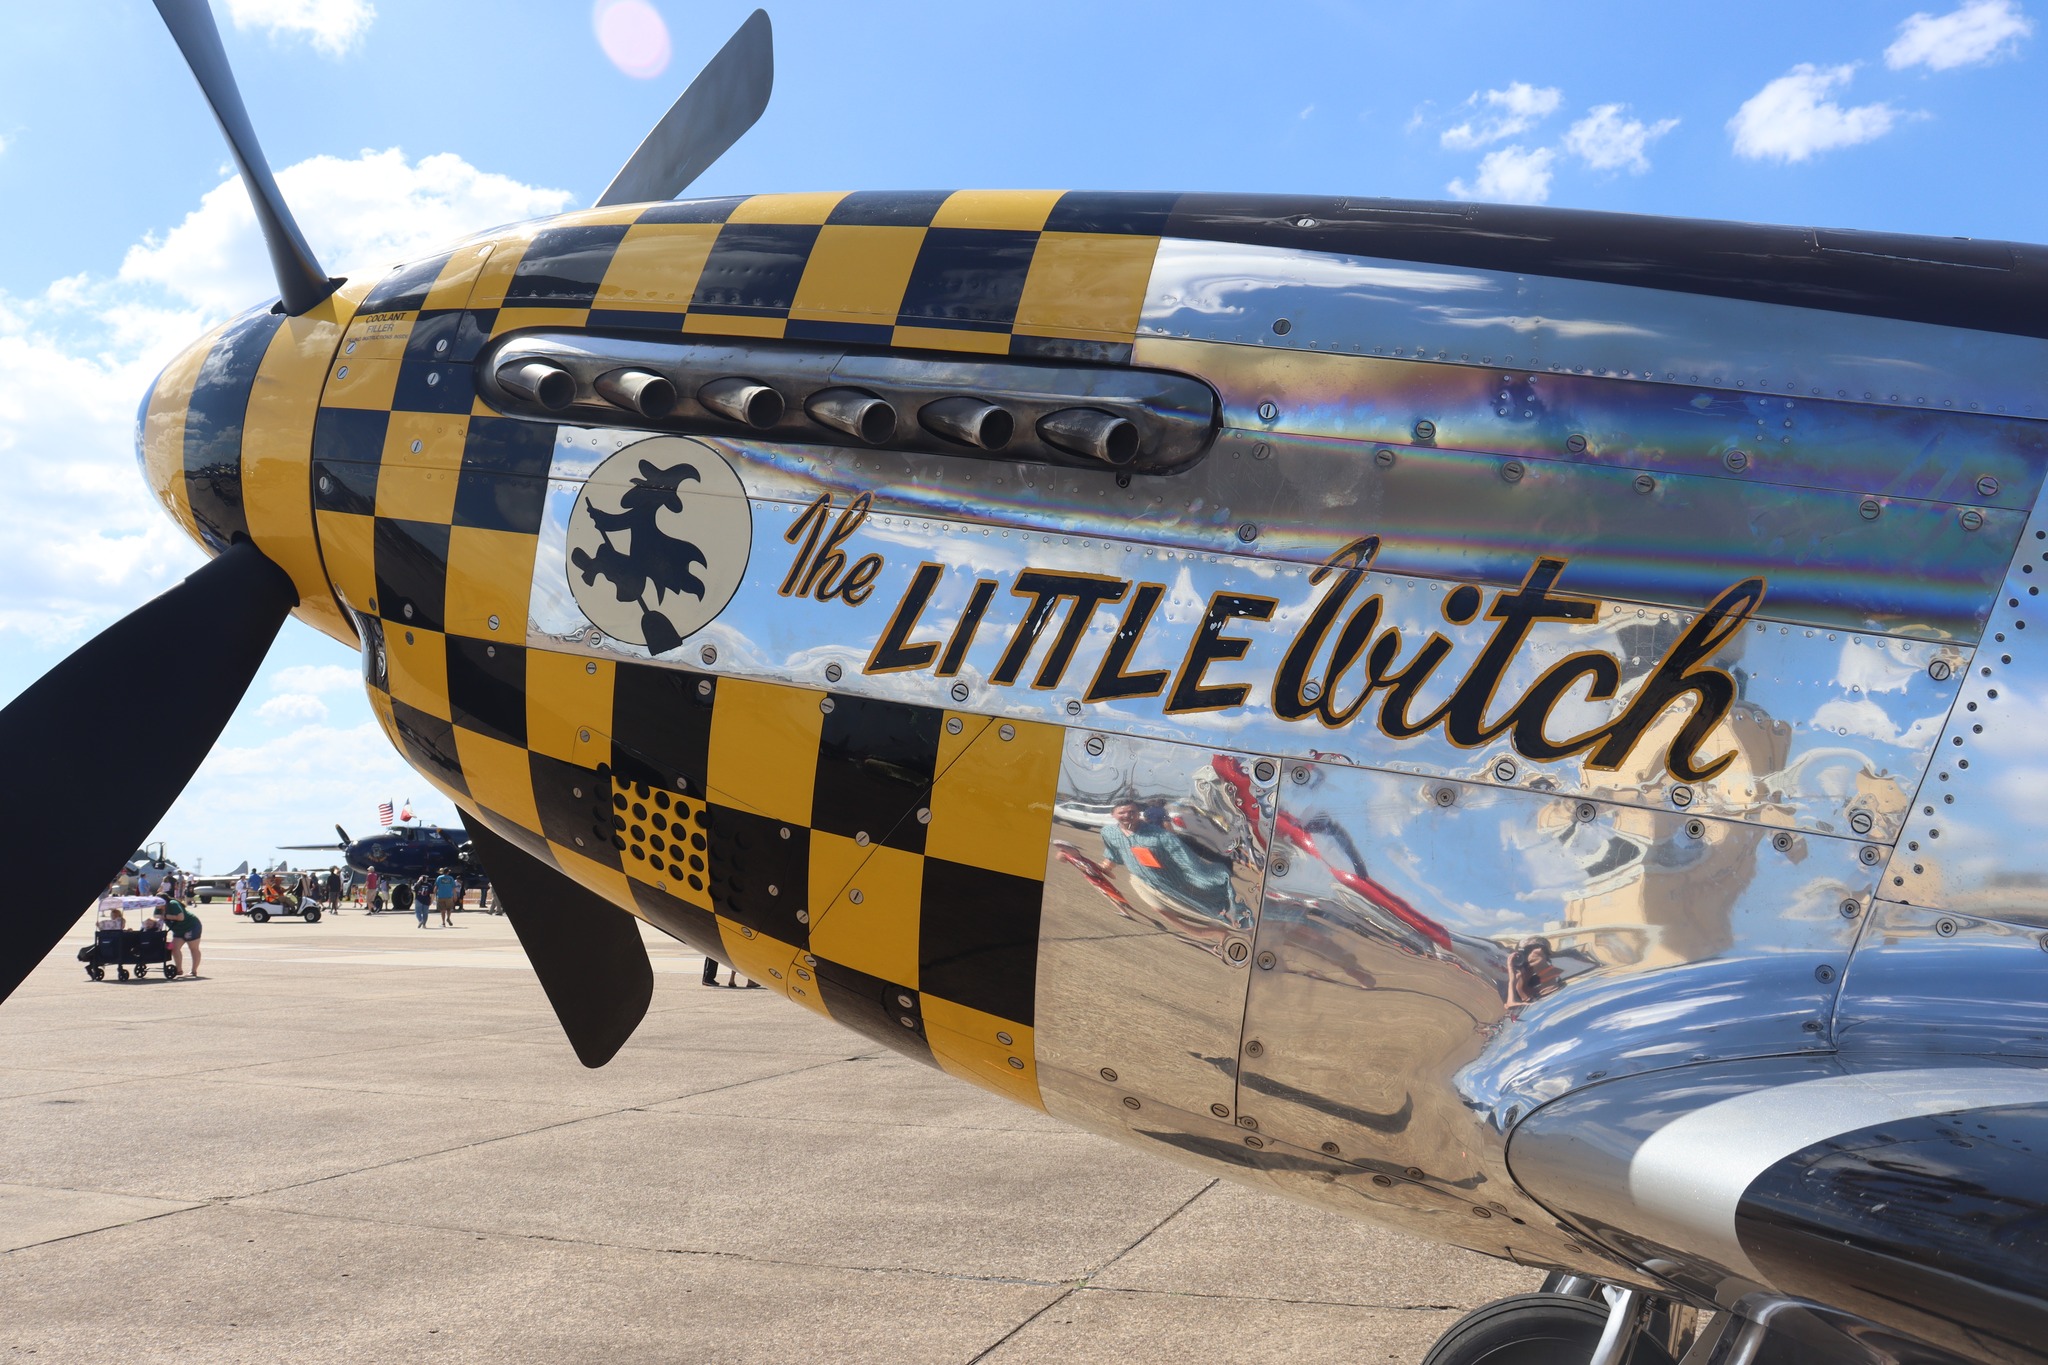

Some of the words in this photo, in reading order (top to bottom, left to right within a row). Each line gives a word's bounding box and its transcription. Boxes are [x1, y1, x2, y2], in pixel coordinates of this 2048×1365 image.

[365, 312, 407, 323] COOLANT
[367, 323, 394, 333] FILLER
[779, 491, 883, 605] The
[862, 561, 1279, 715] LITTLE
[1271, 534, 1766, 784] Witch
